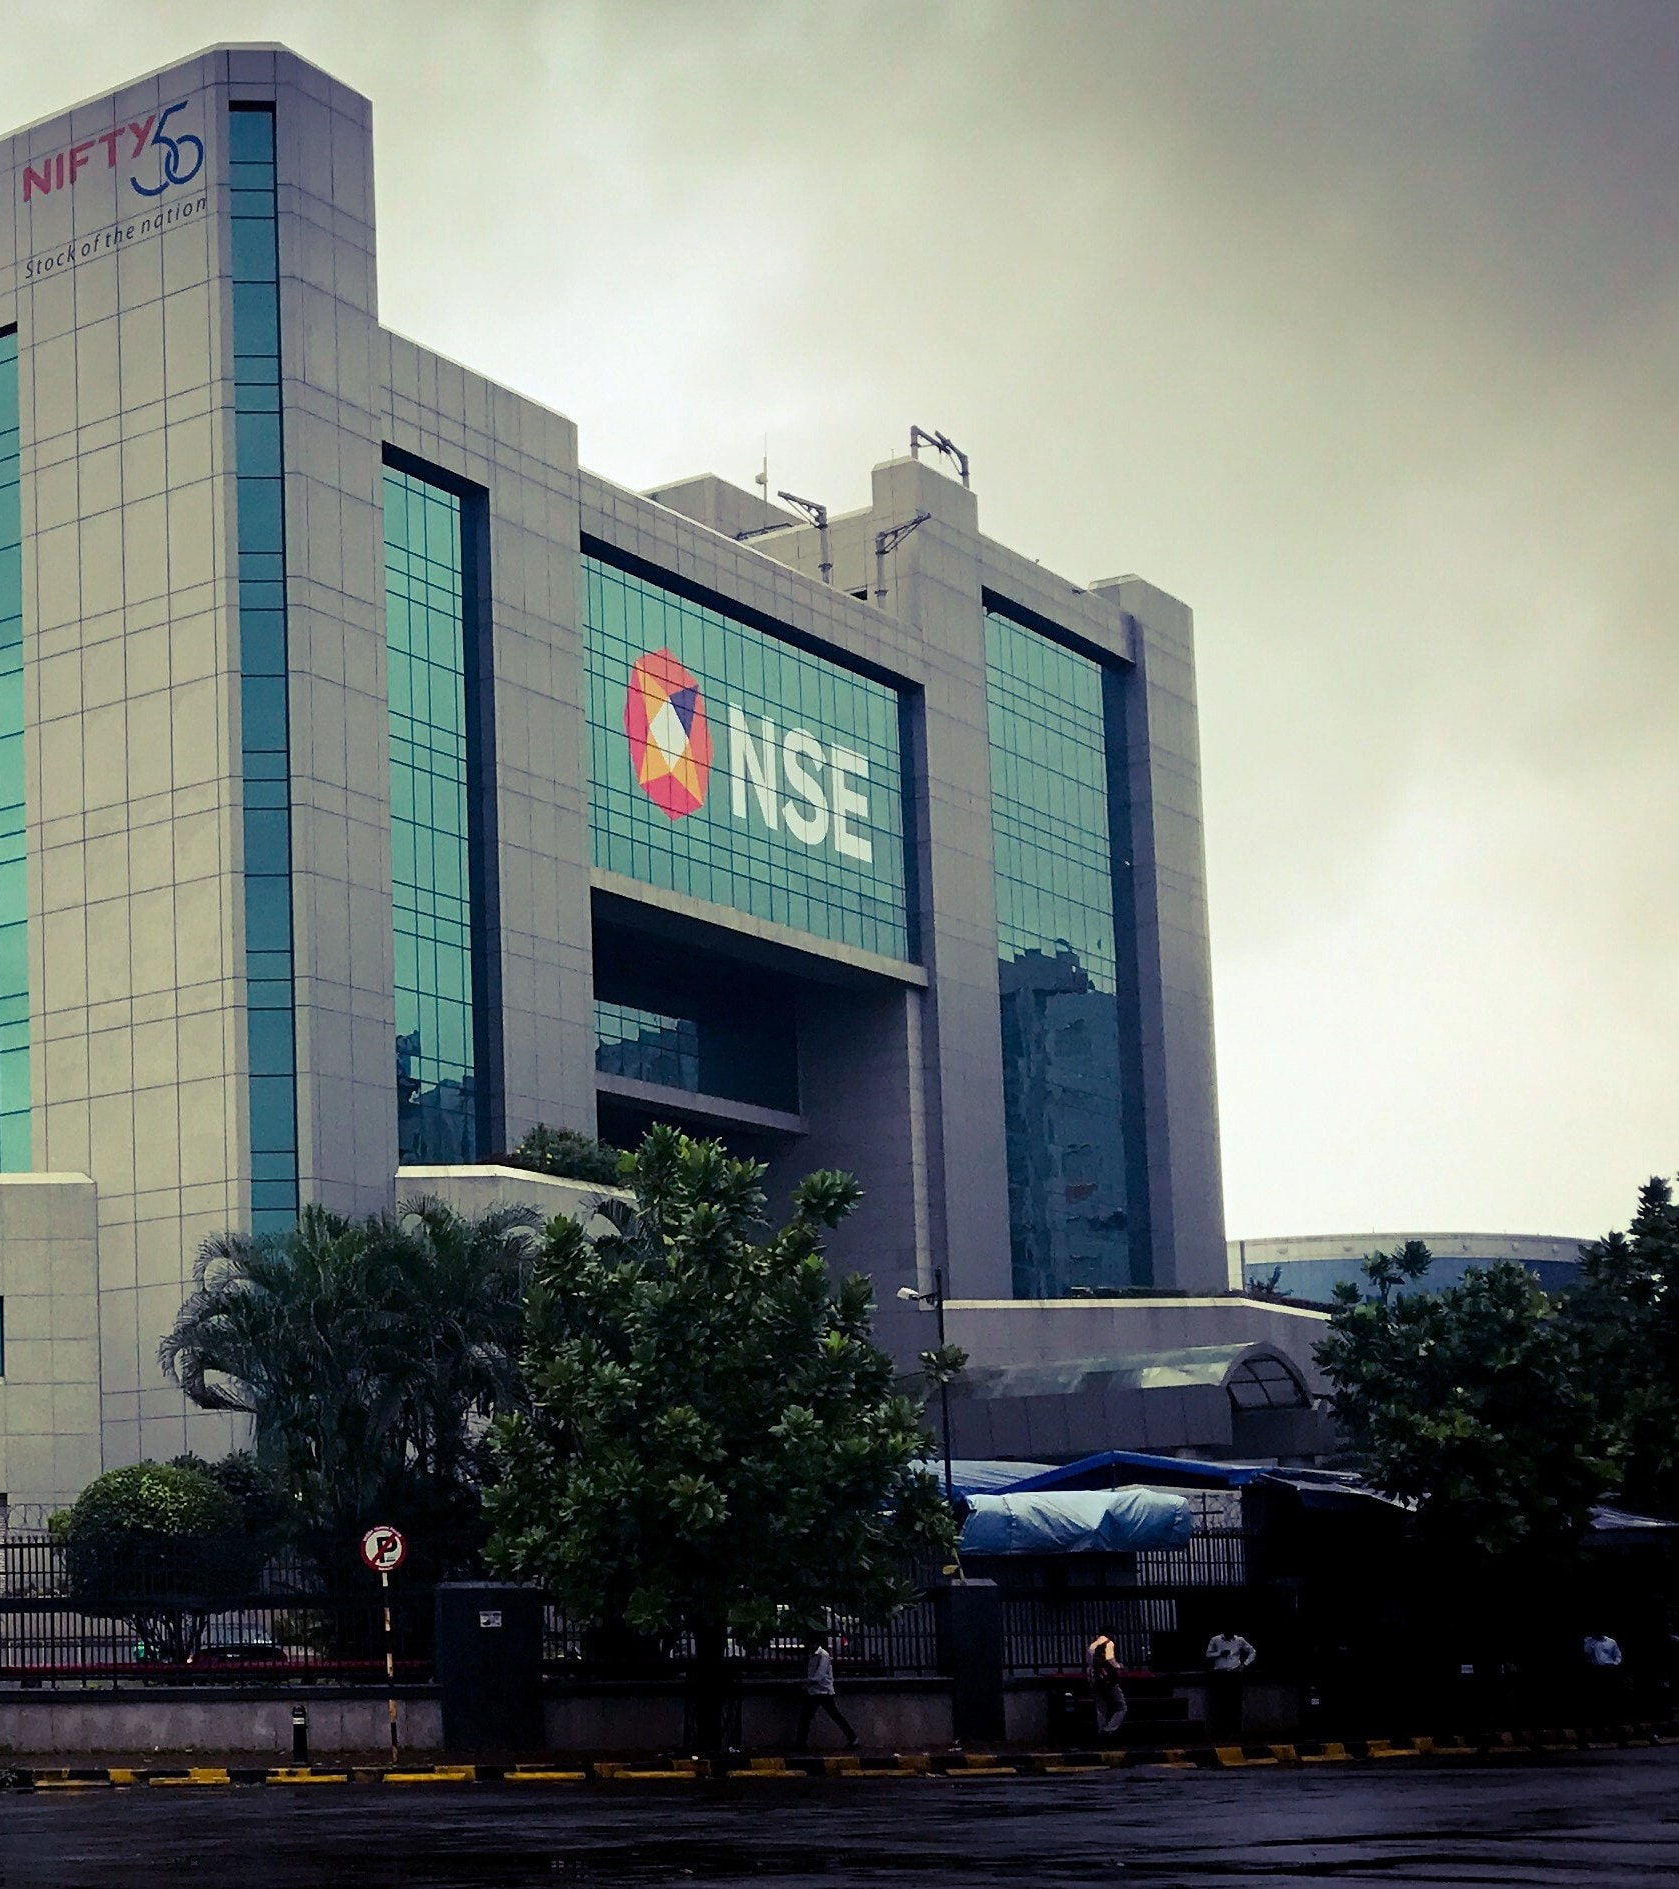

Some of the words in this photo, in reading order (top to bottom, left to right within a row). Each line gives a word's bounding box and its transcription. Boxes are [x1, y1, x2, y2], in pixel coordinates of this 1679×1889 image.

[23, 114, 157, 203] NIFTY
[130, 100, 204, 197] 50
[25, 245, 75, 278] Stock
[81, 234, 101, 257] of
[105, 226, 134, 248] the
[140, 196, 208, 234] nation
[729, 701, 873, 863] NSE
[376, 1536, 398, 1564] P
